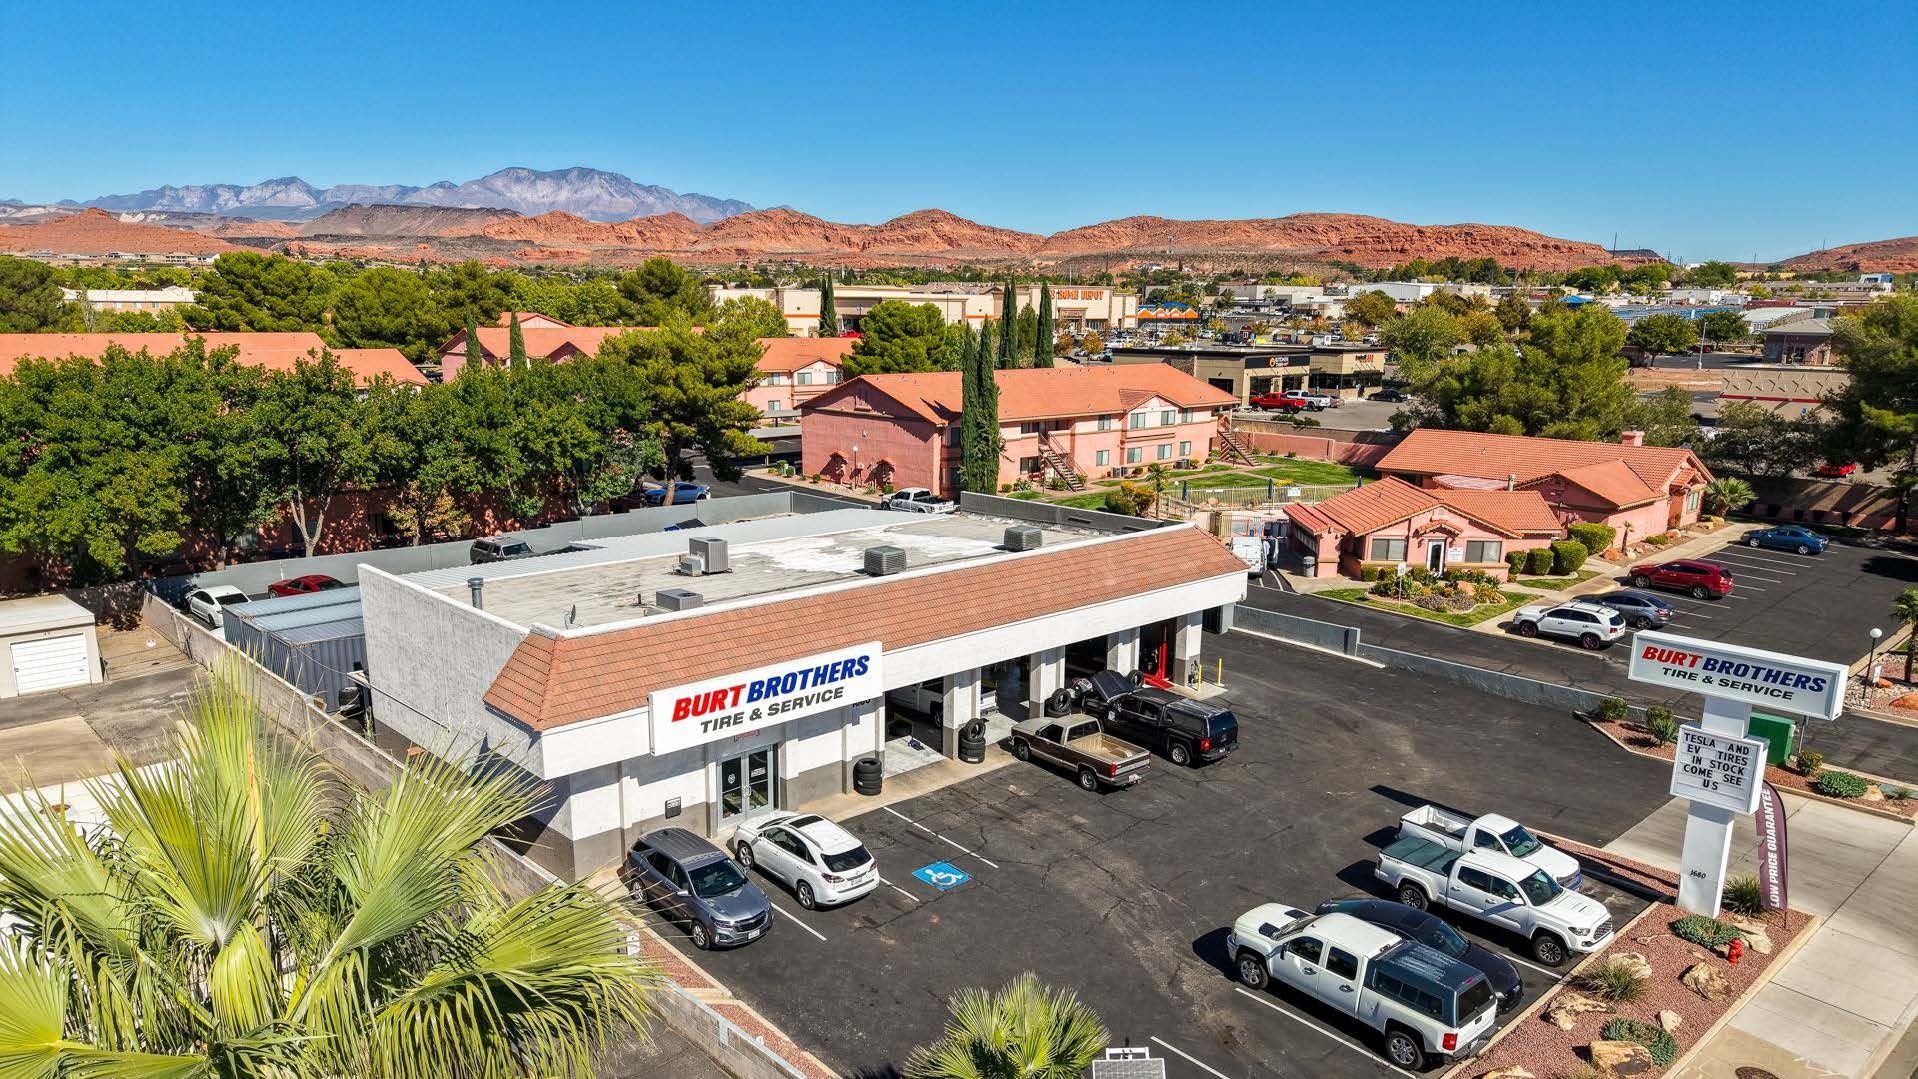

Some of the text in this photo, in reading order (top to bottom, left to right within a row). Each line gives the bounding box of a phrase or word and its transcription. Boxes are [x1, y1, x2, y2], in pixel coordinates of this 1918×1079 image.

[1058, 290, 1079, 300] HOME
[1081, 290, 1104, 301] DEPOT
[1642, 646, 1827, 692] BURT BROTHERS
[672, 655, 870, 722] BURT BROTHERS
[1662, 667, 1795, 700] TIRE & SERVICE
[701, 711, 745, 734] TIRE
[749, 707, 763, 721] &
[767, 686, 844, 717] SERVICE
[1684, 732, 1749, 755] TESLA AND
[1687, 744, 1748, 766] EV TIRES
[1683, 764, 1742, 786] COME SEE
[1692, 755, 1744, 775] IN STOCK
[1703, 779, 1719, 790] US
[1762, 788, 1779, 908] LOW PRICE GUARANTEE
